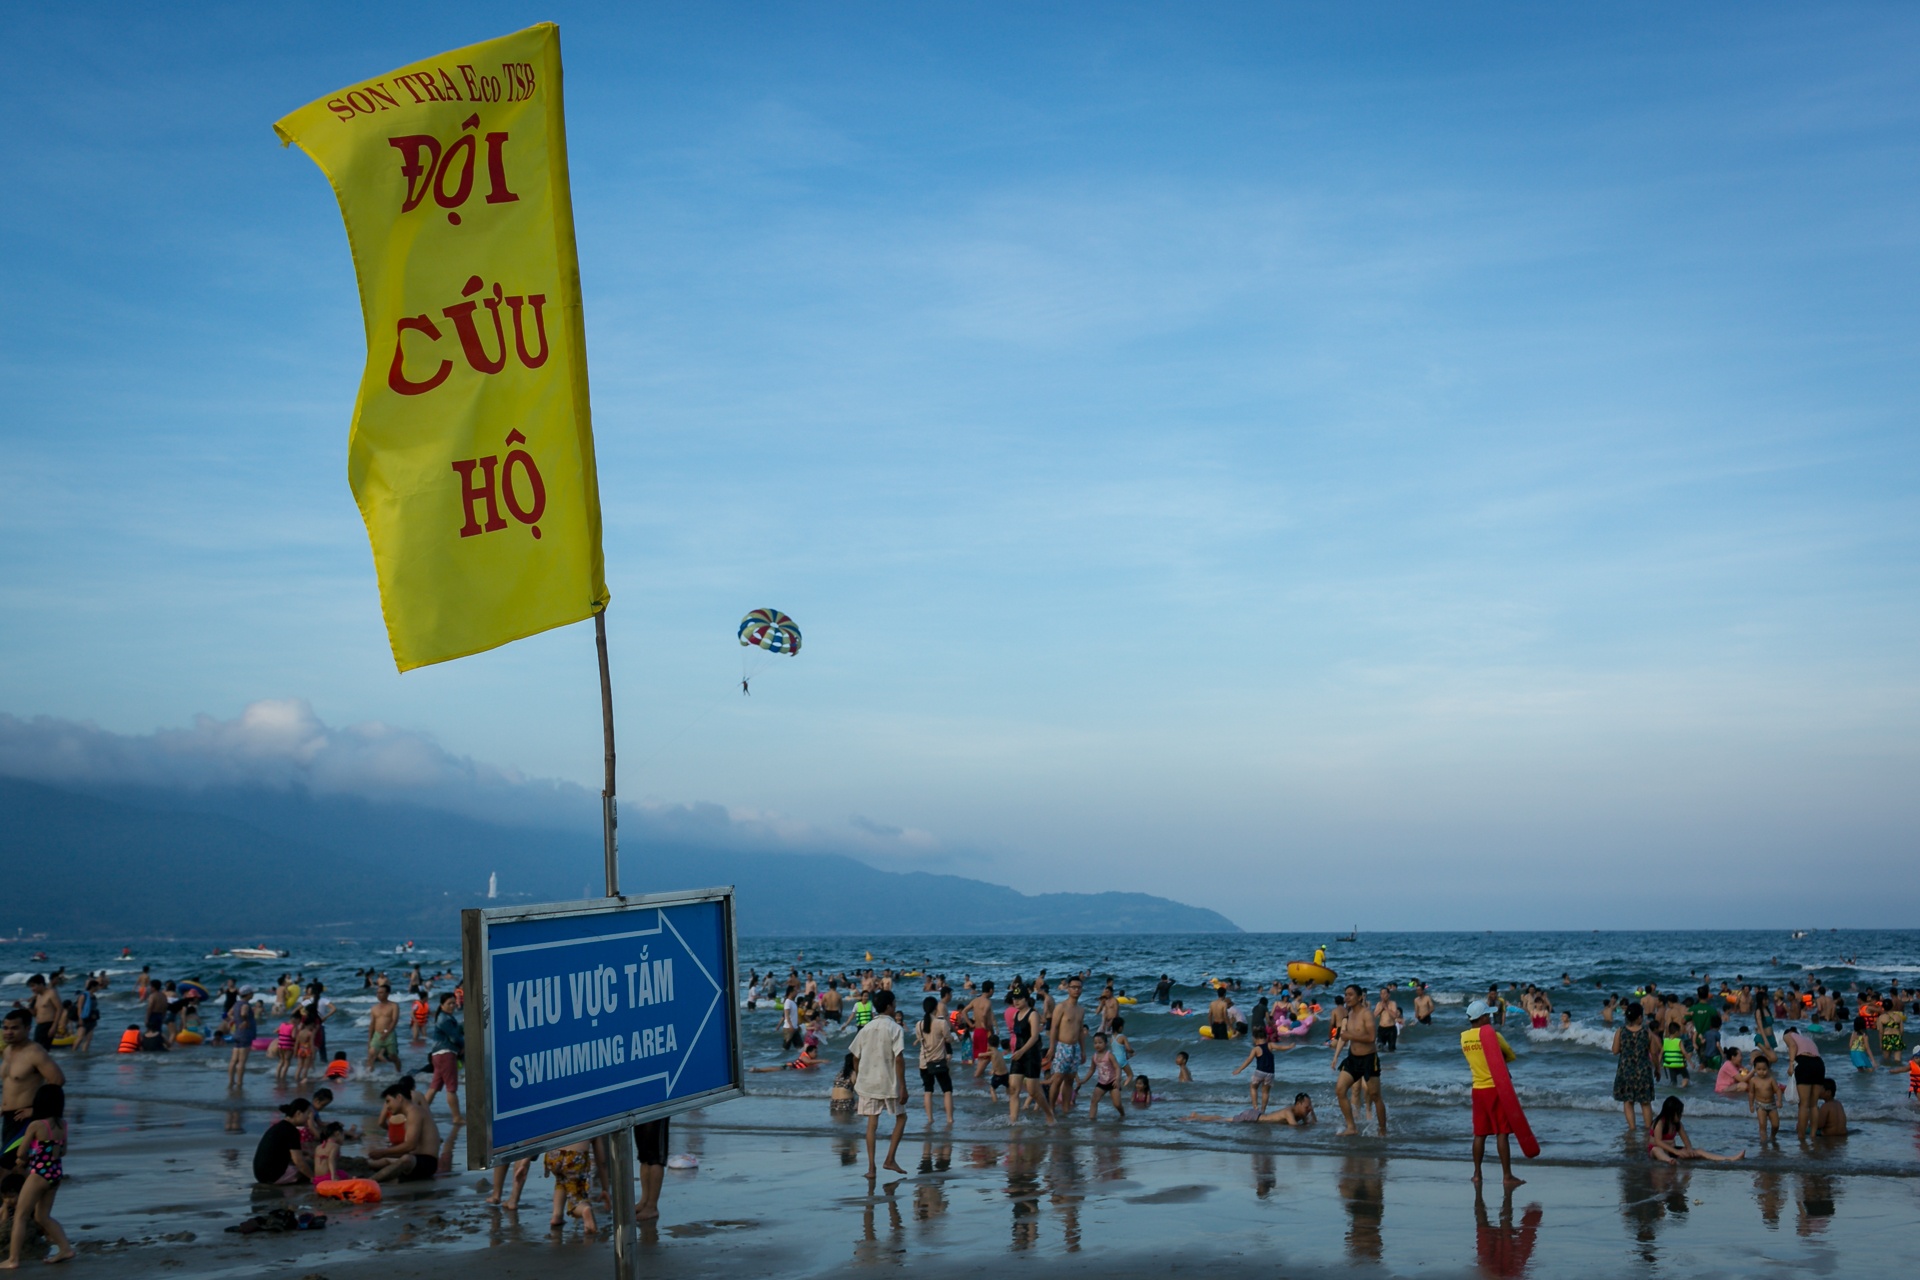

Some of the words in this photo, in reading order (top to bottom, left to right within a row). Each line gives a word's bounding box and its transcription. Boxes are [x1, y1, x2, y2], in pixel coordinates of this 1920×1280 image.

[327, 82, 401, 123] SON
[393, 67, 463, 104] TRA
[457, 64, 501, 103] Eco
[502, 62, 536, 103] TSB
[388, 112, 520, 226] ĐỘI
[388, 275, 549, 396] CỨU
[451, 427, 546, 540] HỘ
[507, 975, 562, 1032] KHU
[569, 963, 618, 1027] VỰC
[624, 944, 674, 1009] TẮM
[509, 1034, 625, 1089] SWIMMING
[630, 1023, 678, 1061] AREA
